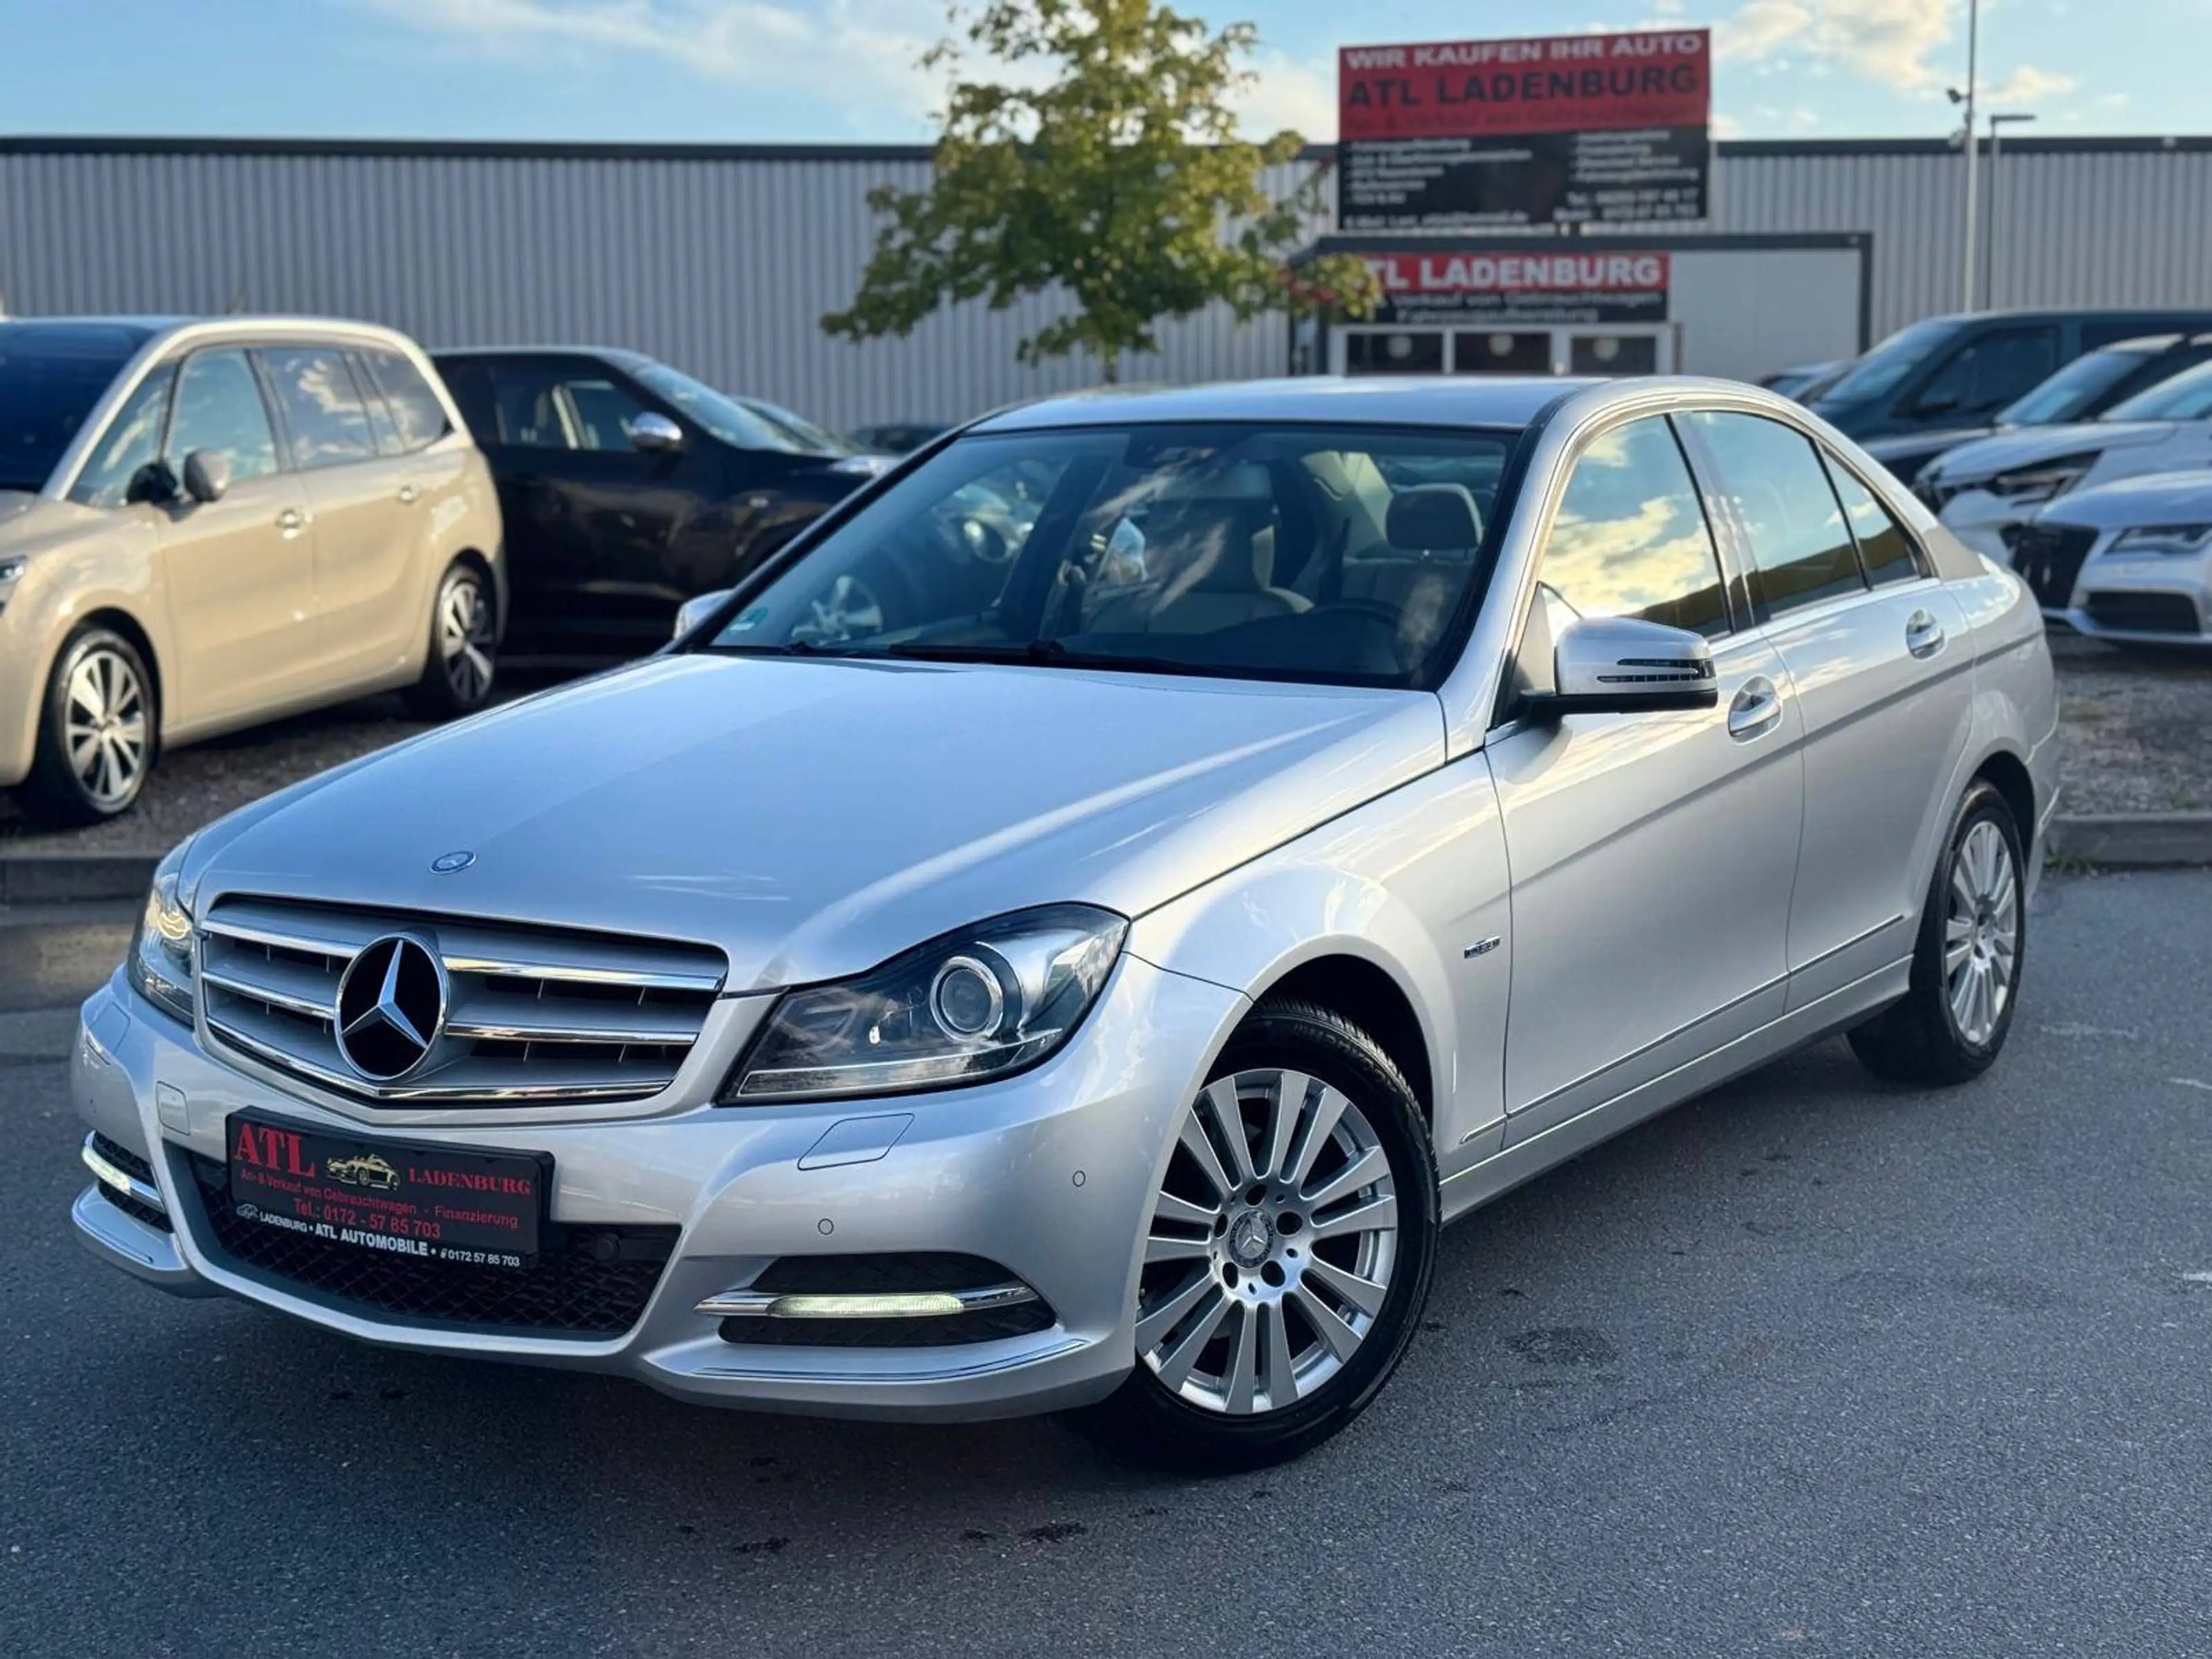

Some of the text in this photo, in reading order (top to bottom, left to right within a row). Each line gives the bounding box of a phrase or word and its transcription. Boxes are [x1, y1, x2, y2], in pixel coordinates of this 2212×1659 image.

[1346, 32, 1703, 70] WIR KAUFEN IHR AUTO
[1347, 63, 1698, 108] ATL LADENBURG
[1364, 257, 1662, 288] TL LADENBURG
[233, 1123, 532, 1196] ATL LADENBURG
[293, 1198, 320, 1219] Tel.:
[323, 1205, 356, 1226] 0172
[370, 1215, 387, 1231] 57
[390, 1218, 409, 1235] 85
[414, 1219, 441, 1240] 703
[323, 1188, 417, 1215] Gebrauchtwagen
[435, 1204, 518, 1229] Finanzierung
[259, 1212, 308, 1233] LADENBURG
[315, 1223, 338, 1240] ATL
[340, 1229, 429, 1257] AUTOMOBILE
[447, 1249, 472, 1262] 0172
[474, 1252, 485, 1263] 57
[502, 1255, 521, 1268] 703
